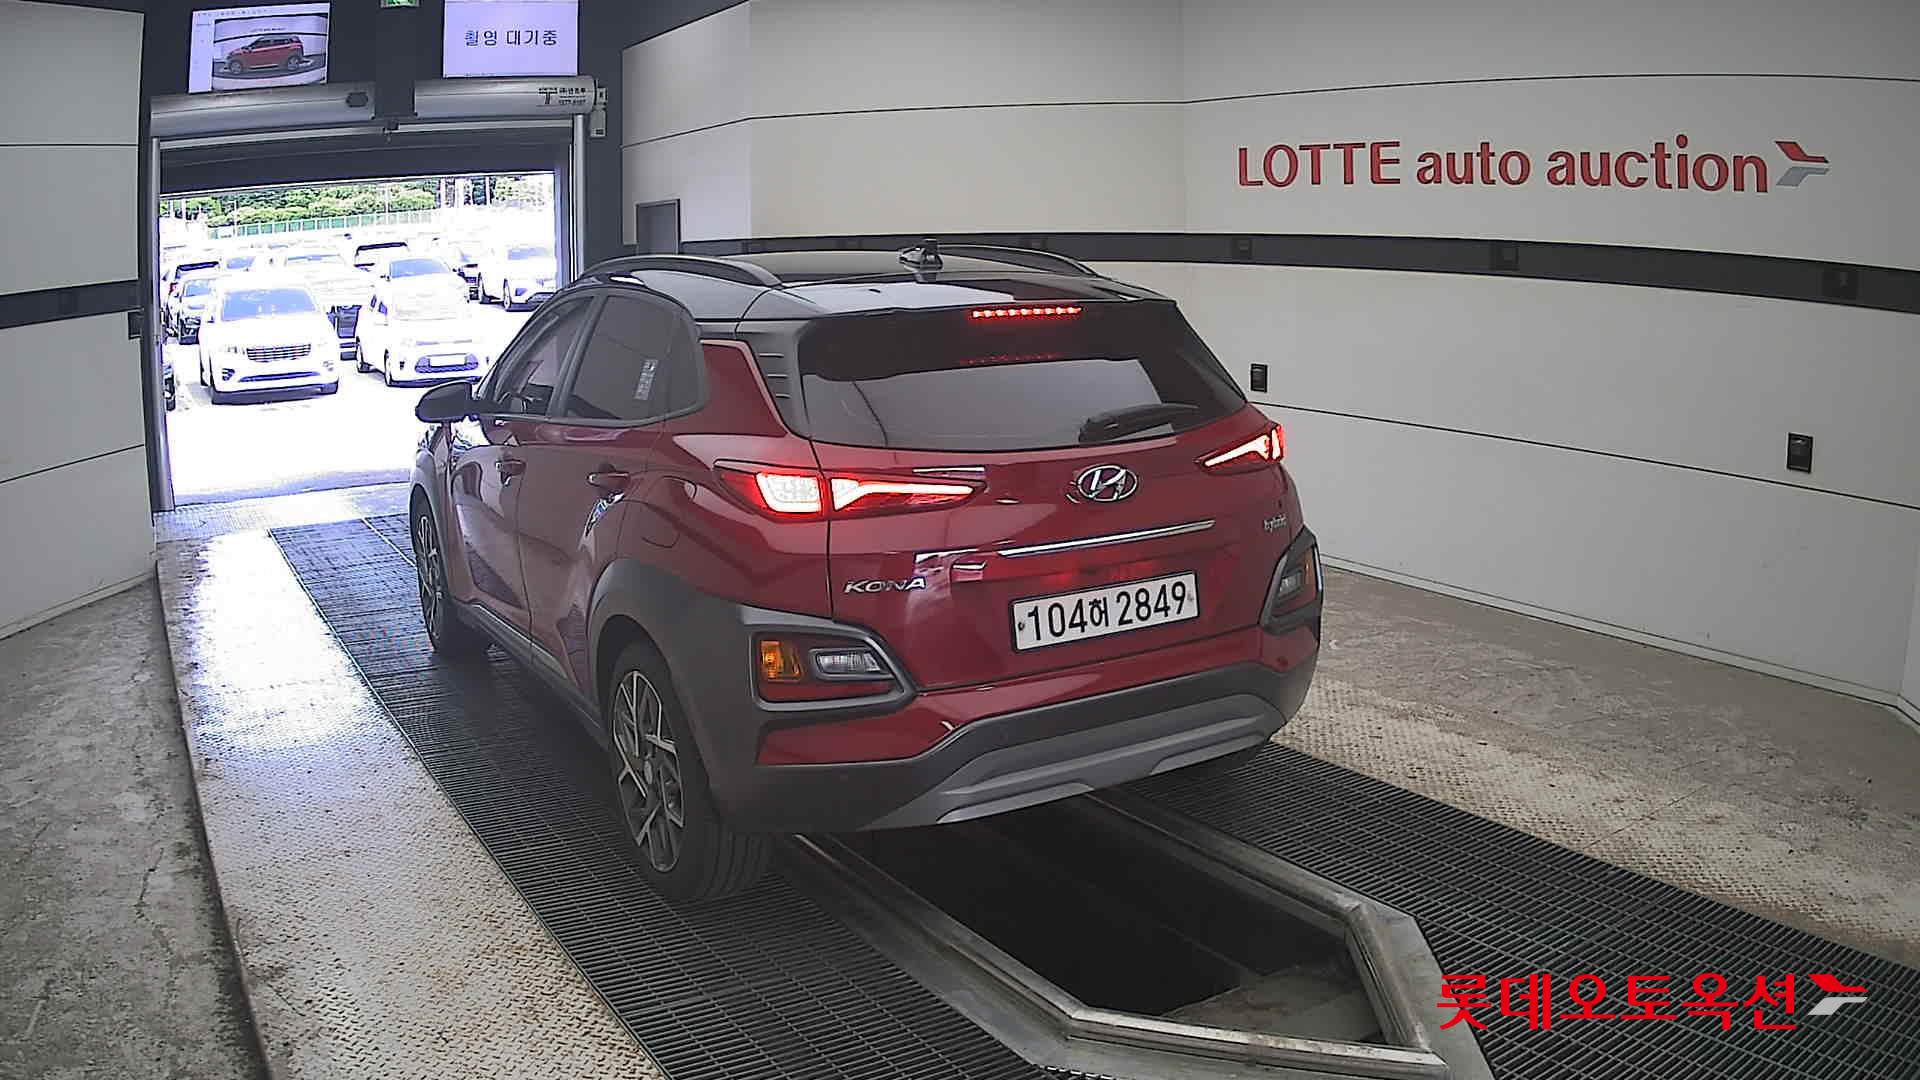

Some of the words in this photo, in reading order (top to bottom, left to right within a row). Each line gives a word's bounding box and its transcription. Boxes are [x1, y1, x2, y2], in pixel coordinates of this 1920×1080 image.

[506, 30, 558, 46] 대기중
[1239, 141, 1400, 187] LOTTE
[1415, 140, 1532, 187] auto
[1545, 134, 1768, 193] auction
[844, 577, 925, 593] KONA
